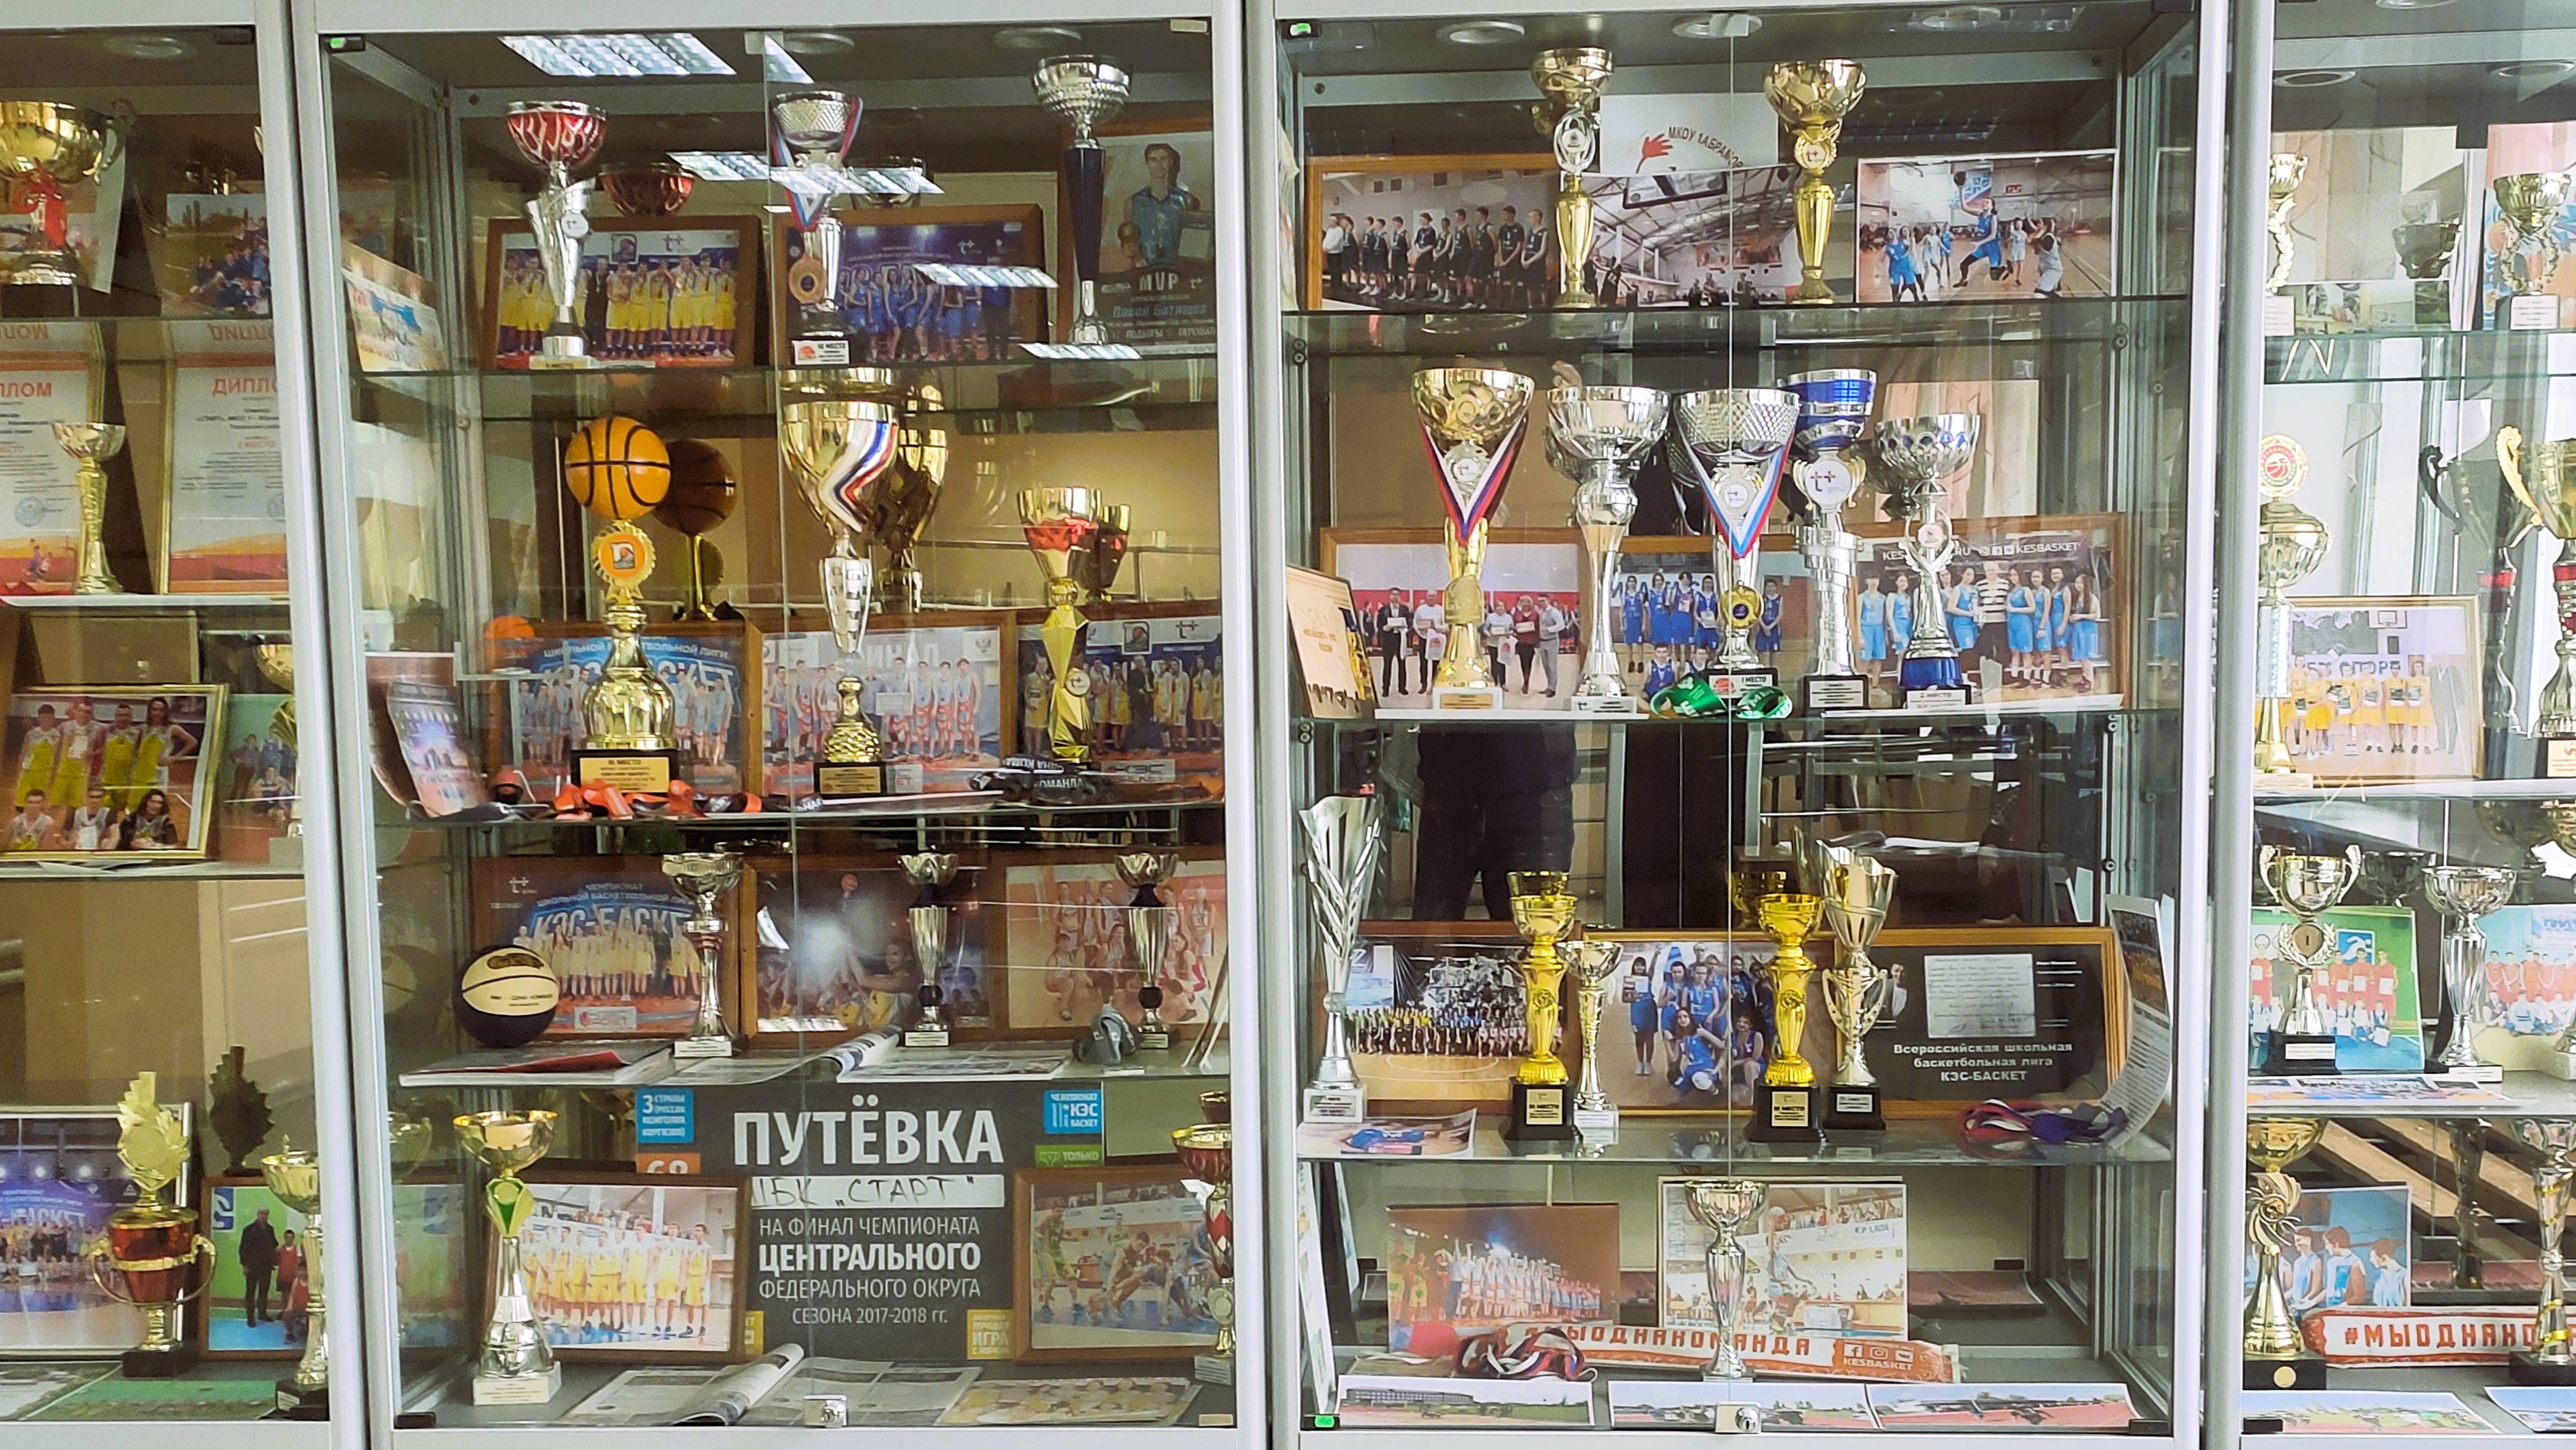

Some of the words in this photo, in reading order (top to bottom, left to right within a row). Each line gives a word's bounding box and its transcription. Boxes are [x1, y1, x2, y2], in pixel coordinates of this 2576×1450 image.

[1139, 271, 1178, 291] MVP
[2016, 542, 2078, 554] KESBASKET
[1894, 1043, 1999, 1056] Всероссийская
[2005, 1043, 2073, 1053] школьная
[1914, 1058, 2017, 1068] баскетбольная
[1940, 1071, 2028, 1082] КЭС-БАСКЕТ
[734, 1094, 1004, 1166] ПУТЁВКА
[759, 1218, 784, 1236] НА
[788, 1218, 854, 1236] ФИНАЛ
[859, 1216, 980, 1236] ЧЕМПИОНАТА
[759, 1242, 981, 1277] ЦЕНТРАЛЬНОГО
[759, 1279, 906, 1301] ФЕДЕРАЛЬНОГО
[913, 1278, 981, 1298] ОКРУГА
[792, 1309, 852, 1324] СЕЗОНА
[856, 1308, 927, 1323] 2017-2018
[972, 1331, 1009, 1346] ИГРА
[1843, 1357, 1914, 1370] KESBASKET
